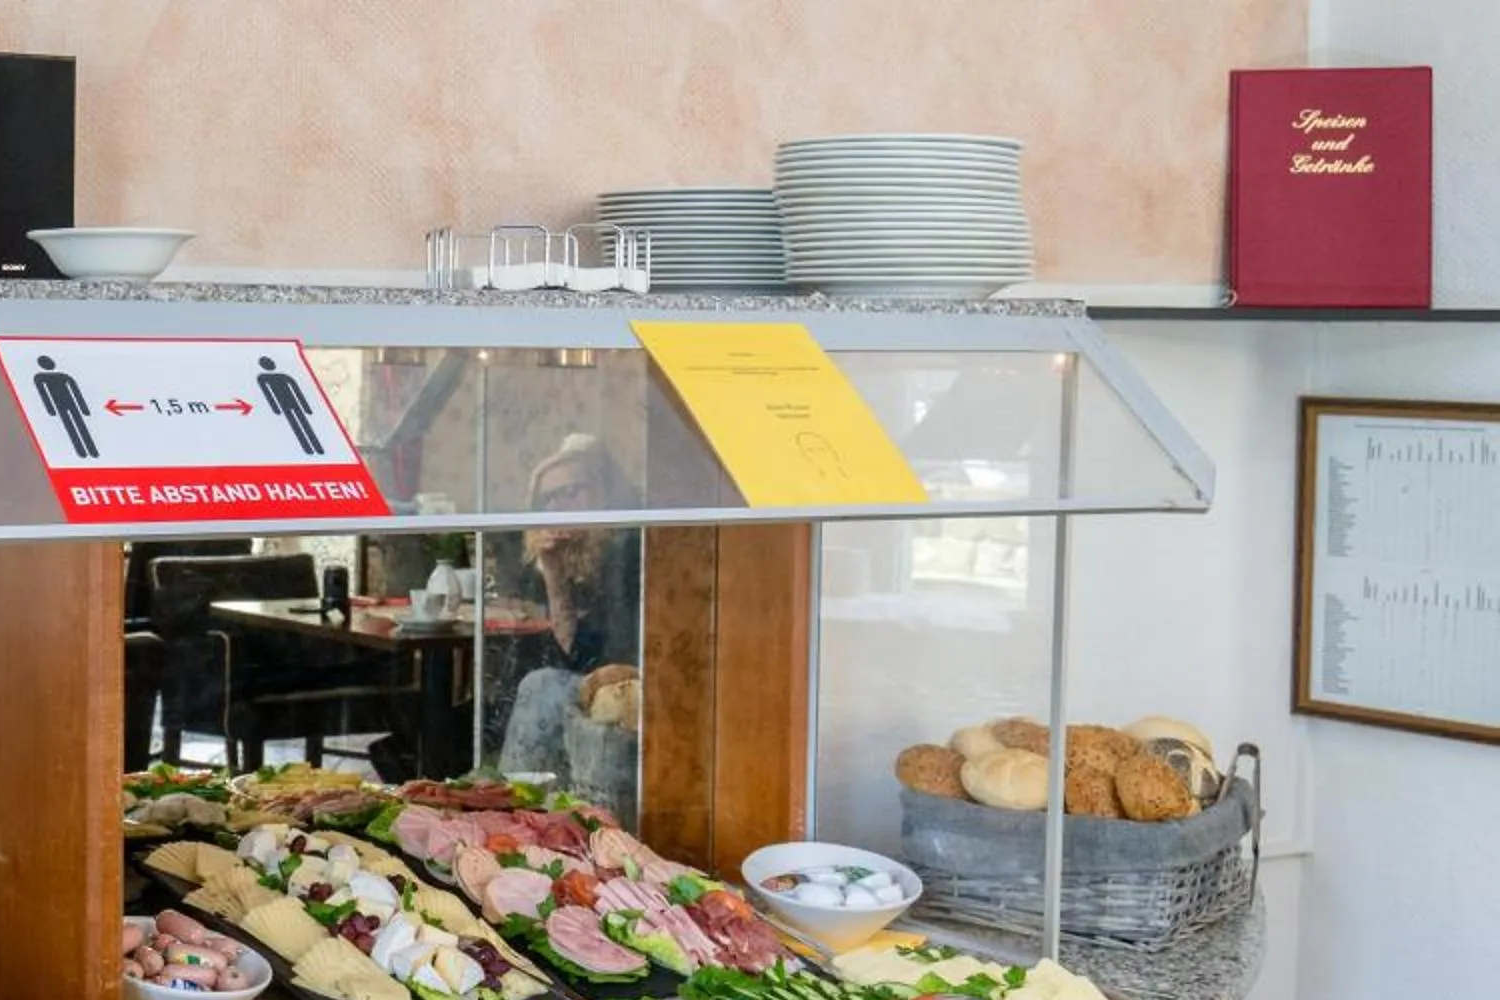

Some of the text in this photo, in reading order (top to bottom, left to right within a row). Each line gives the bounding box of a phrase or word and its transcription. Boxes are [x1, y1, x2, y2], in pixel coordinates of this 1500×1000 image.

[1292, 109, 1367, 134] Speisen
[1311, 133, 1355, 151] und
[1289, 154, 1375, 173] Getränke
[1, 263, 26, 271] SONY
[149, 398, 209, 416] 1,5 m
[70, 481, 368, 505] BITTE ABSTAND HALTEN!
